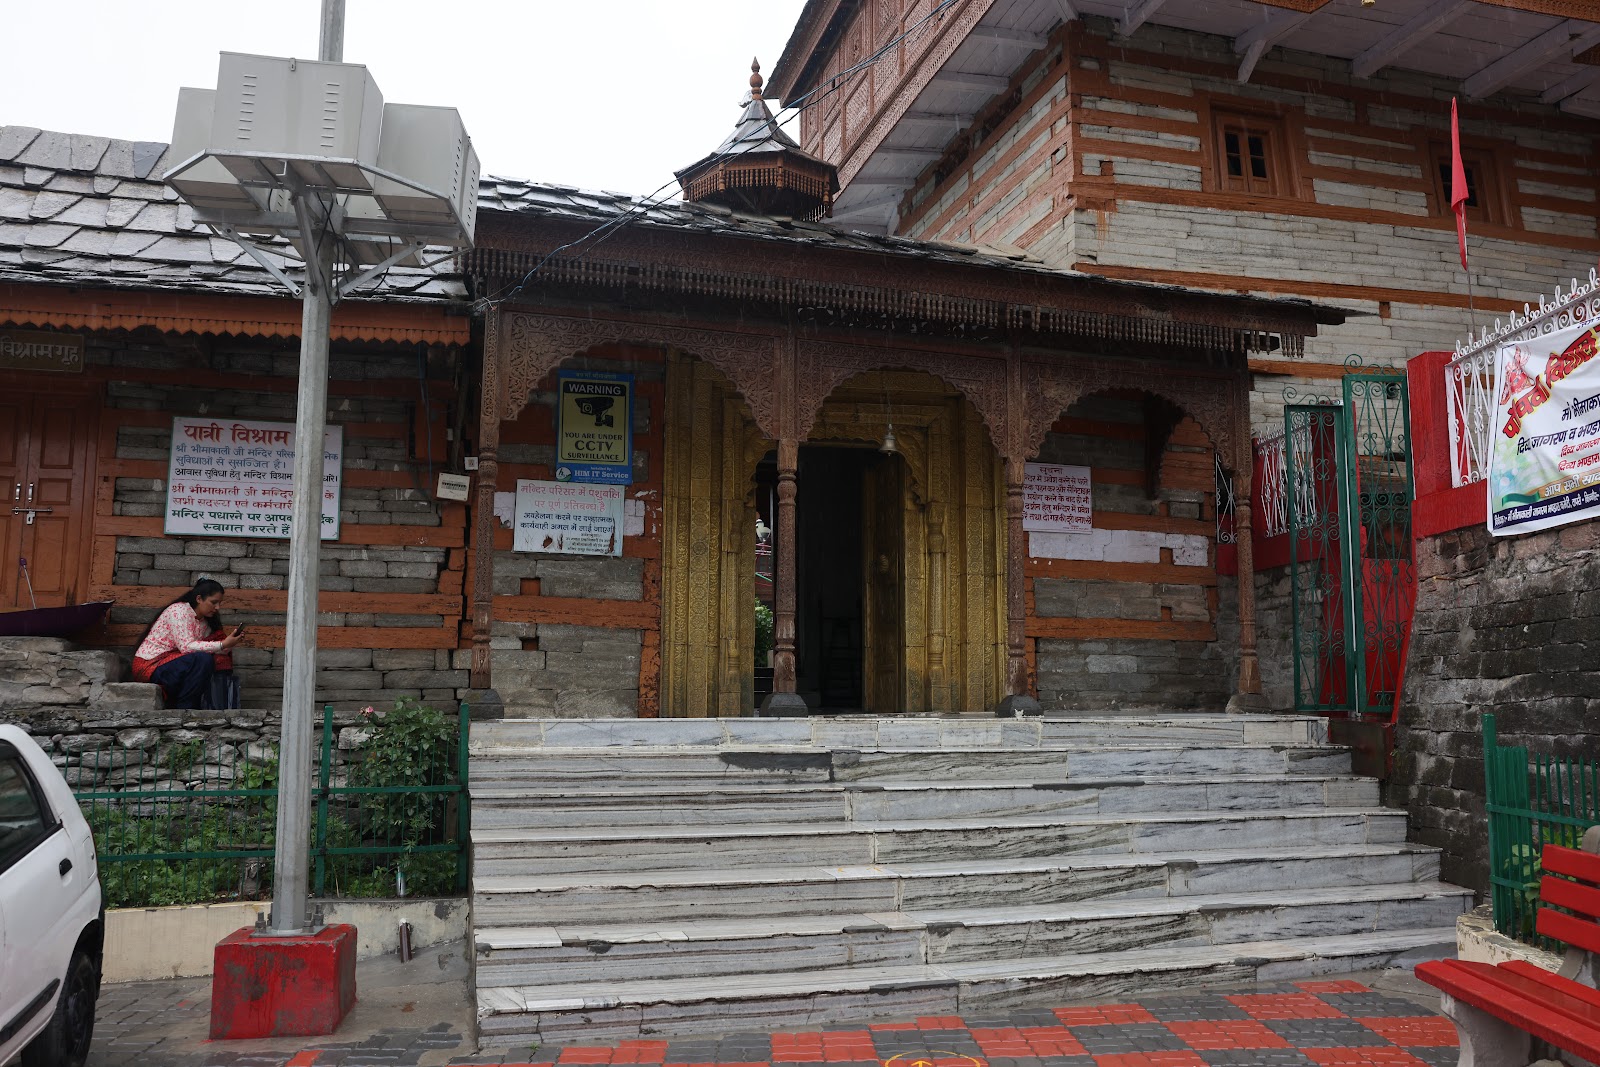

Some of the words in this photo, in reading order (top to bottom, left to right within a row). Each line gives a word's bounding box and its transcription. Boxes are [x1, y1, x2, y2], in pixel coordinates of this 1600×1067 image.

[568, 383, 621, 395] WARNING
[184, 422, 224, 443] यात्री
[229, 423, 291, 446] विश्राम
[176, 443, 187, 453] श्री
[191, 444, 231, 455] भीमाकाली
[233, 446, 245, 456] जी
[248, 447, 272, 458] मन्दिर
[574, 440, 613, 451] CCTV
[216, 457, 226, 466] से
[567, 452, 619, 460] SURVEILLANCE
[174, 467, 202, 477] आवास
[243, 469, 267, 480] मन्दिर
[270, 470, 293, 480] विश्राम
[602, 471, 629, 479] Service
[1024, 473, 1036, 482] न्दिर
[172, 483, 185, 493] श्री
[189, 484, 240, 496] भीमाकाली
[244, 486, 258, 497] जी
[324, 490, 335, 500] के
[521, 481, 546, 494] मन्दिर
[549, 485, 576, 496] परिसर
[578, 486, 587, 496] में
[588, 488, 620, 500] पशुबलि
[171, 507, 204, 520] मन्दिर
[208, 510, 243, 521] पधारने
[246, 512, 261, 522] पर
[203, 522, 244, 533] स्वागत
[248, 523, 278, 534] करते
